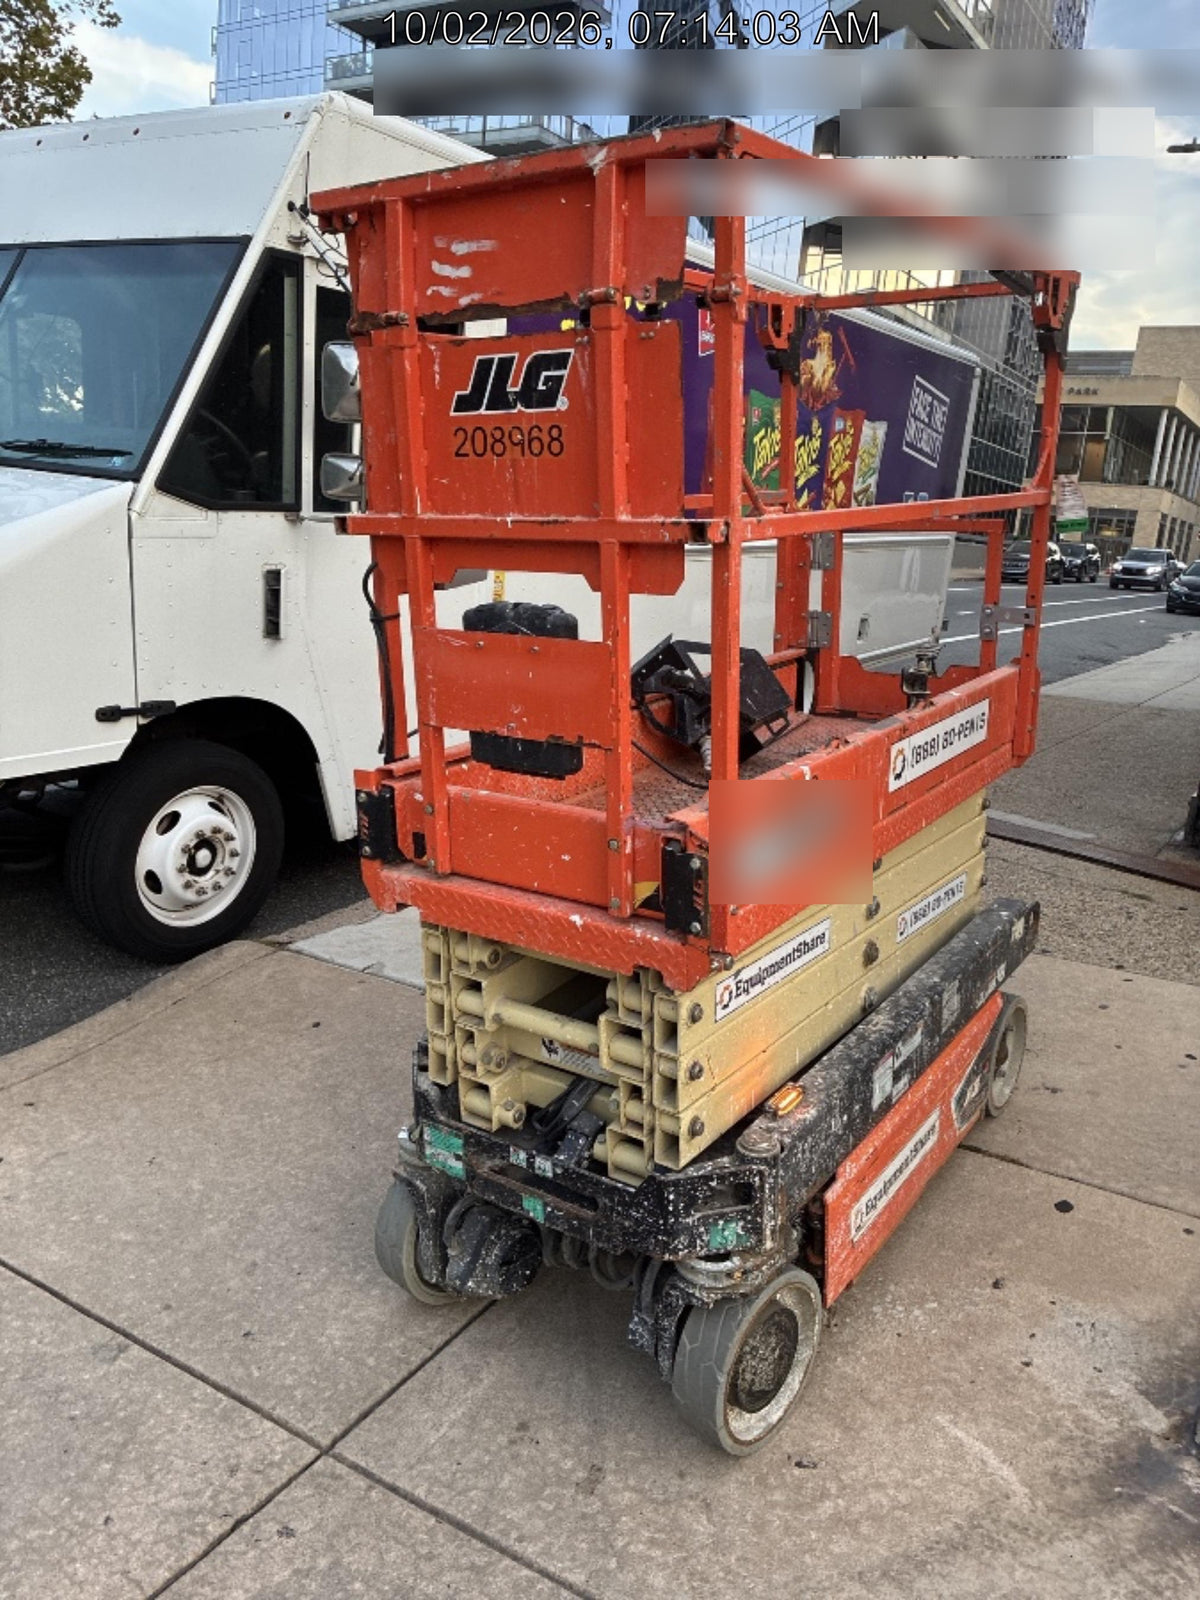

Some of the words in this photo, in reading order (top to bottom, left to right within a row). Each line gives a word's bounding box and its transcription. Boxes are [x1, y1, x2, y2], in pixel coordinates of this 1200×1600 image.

[450, 348, 575, 416] JLG
[1068, 387, 1099, 396] PARK
[453, 424, 564, 458] 208968
[734, 931, 827, 1000] EquipmentShare
